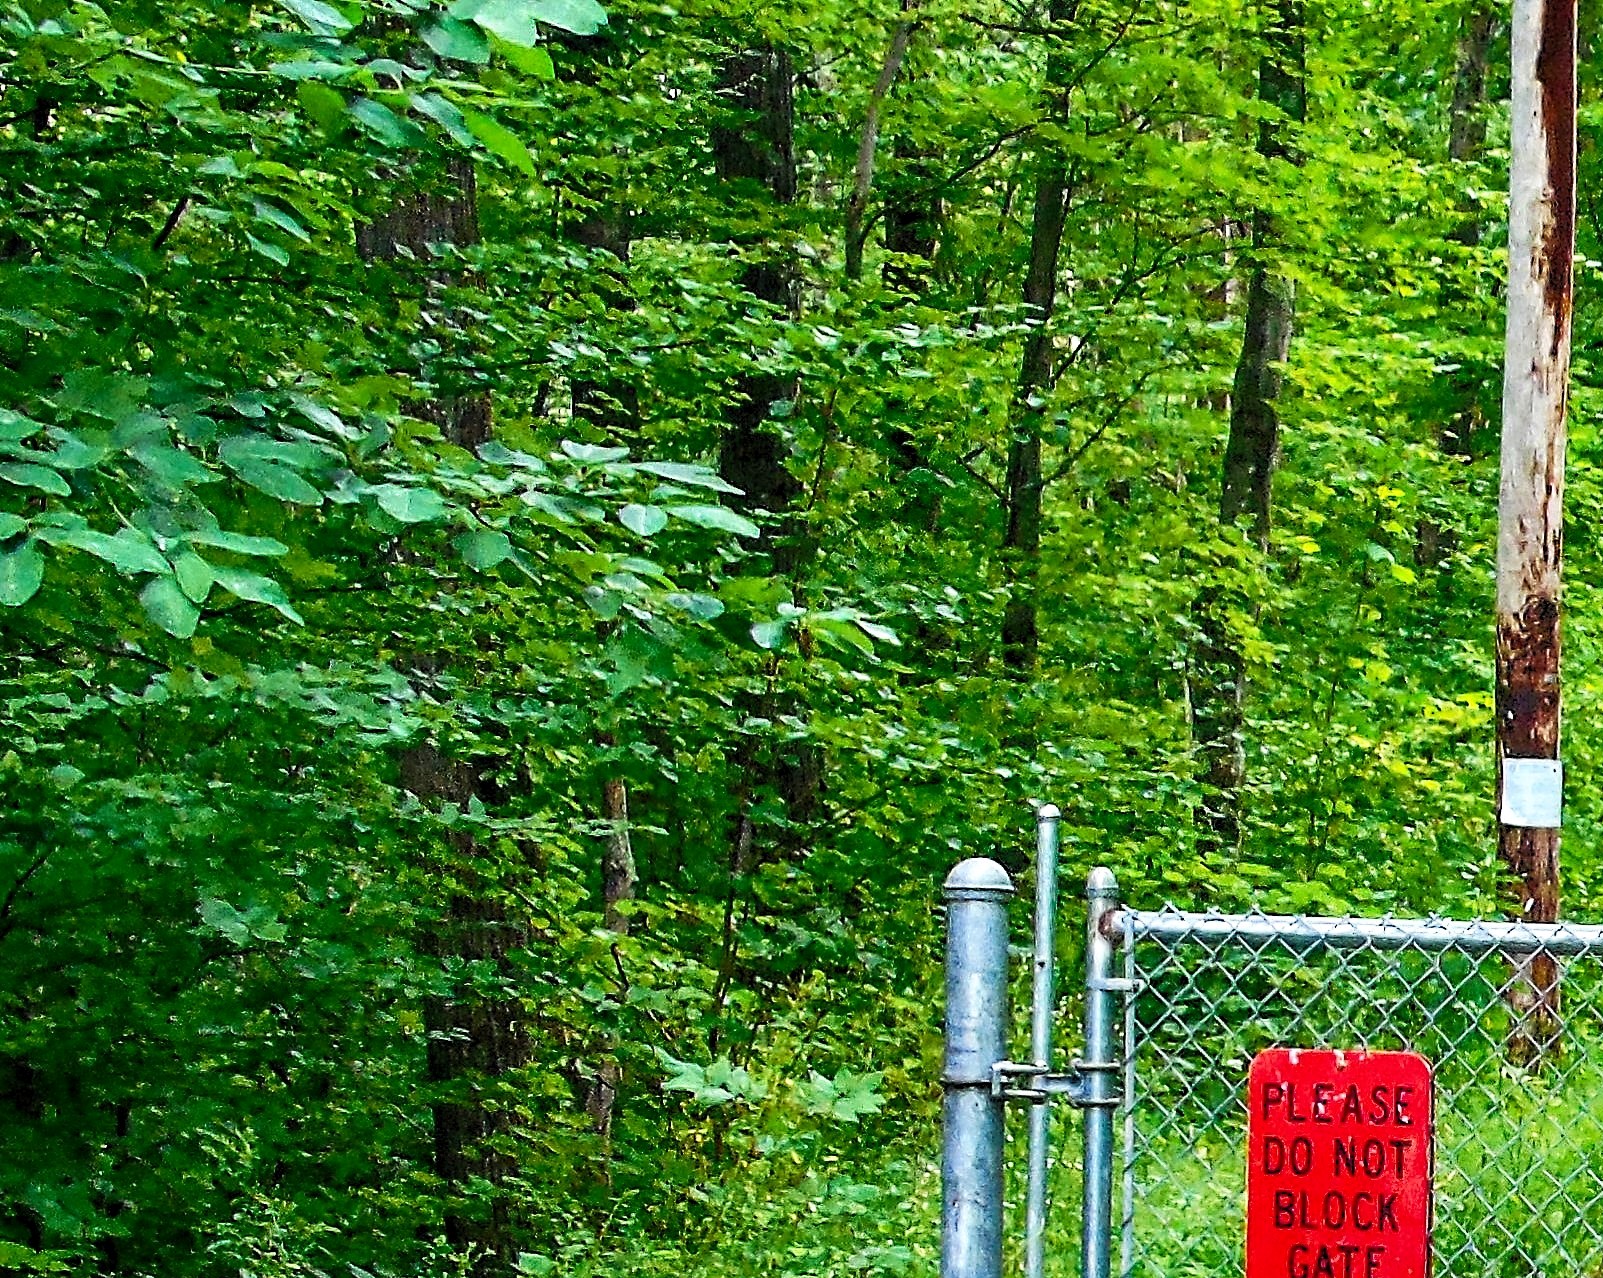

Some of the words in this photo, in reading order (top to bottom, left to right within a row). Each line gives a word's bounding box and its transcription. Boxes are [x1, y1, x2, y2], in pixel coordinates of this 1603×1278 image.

[1262, 1082, 1414, 1125] PLEASE
[1263, 1136, 1313, 1176] DO
[1334, 1137, 1413, 1179] NOT
[1274, 1190, 1400, 1231] BLOCK
